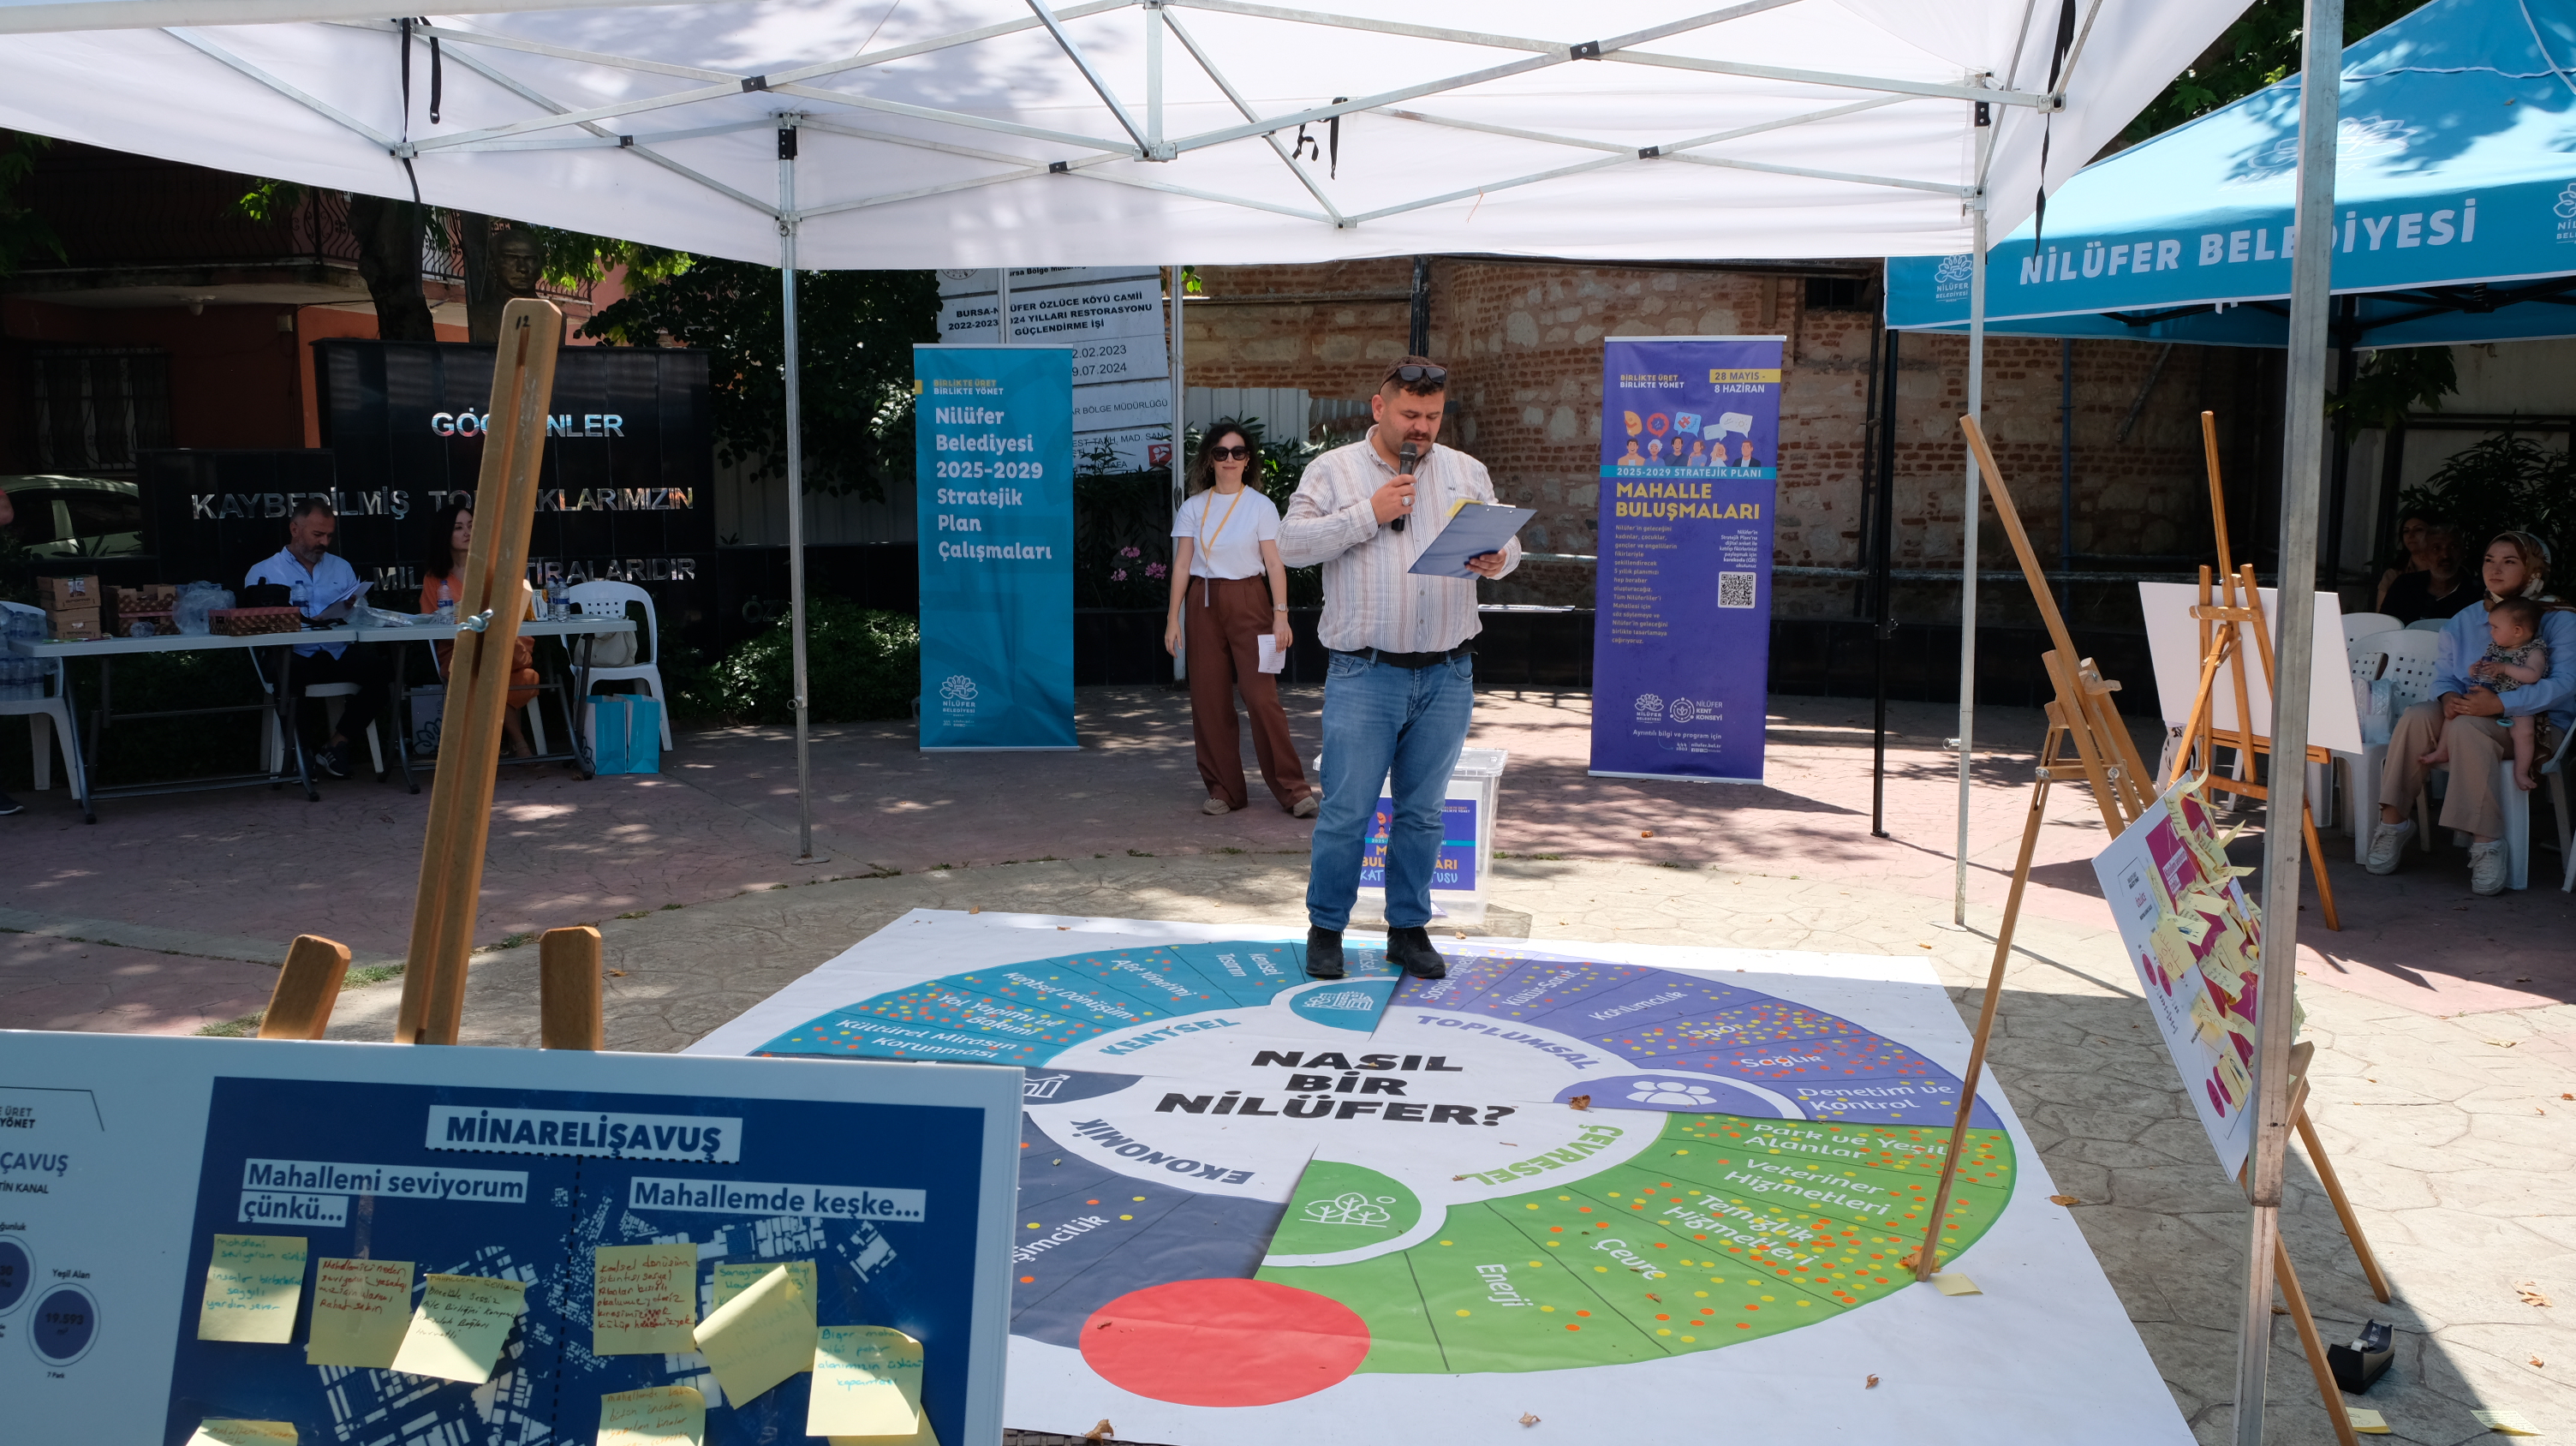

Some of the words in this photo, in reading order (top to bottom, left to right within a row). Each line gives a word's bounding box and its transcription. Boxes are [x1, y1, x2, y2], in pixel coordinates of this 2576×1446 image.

[2019, 241, 2180, 285] NİLÜFER
[1937, 283, 1969, 292] NİLÜFER
[956, 302, 1036, 318] BURSA-NÜFER
[1039, 299, 1079, 310] ÖZLÜCE
[1082, 295, 1111, 305] KÖYÜ
[1113, 291, 1142, 302] CAMİİ
[1029, 313, 1067, 323] YILLARI
[1070, 303, 1153, 318] RESTORASYONU
[516, 314, 531, 331] 12
[1015, 320, 1088, 337] GÜÇLENDİRME
[1091, 319, 1105, 329] İŞİ
[1072, 344, 1127, 359] 2.02.2023
[1072, 362, 1127, 376] 9.07.2024
[1714, 372, 1727, 381] 28
[1730, 372, 1760, 380] MAYIS
[933, 386, 974, 395] BİRLİKTE
[975, 386, 1005, 396] YÖNET
[975, 379, 997, 387] ÜRET
[1658, 380, 1685, 389] YÖNET
[1714, 385, 1720, 393] 8
[1722, 383, 1765, 393] HAZİRAN
[935, 407, 1005, 425] Nilüfer
[1082, 404, 1112, 415] BÖLGE
[1113, 398, 1168, 411] MÜDÜRLÜĞÜ
[432, 408, 624, 437] GÖNLER
[936, 433, 1034, 456] Belediyesi
[1121, 433, 1143, 443] MAD.
[937, 461, 1043, 479] 2025-2029
[1617, 467, 1671, 476] 2025-2029
[1674, 467, 1727, 477] STRATEJİK
[1731, 469, 1762, 478] PLANI
[428, 487, 693, 512] TOKLARIMIZIN
[937, 487, 1023, 509] Stratejik
[1616, 482, 1712, 499] MAHALLE
[1615, 502, 1760, 521] BULUŞMALARI
[938, 514, 981, 532] Plan
[939, 541, 1052, 562] Çalışmaları
[526, 558, 696, 584] TIRALARIDIR
[1696, 700, 1723, 708] NİLÜFER
[1658, 730, 1673, 738] bilgi
[1216, 953, 1247, 977] Tasarım
[1249, 953, 1285, 976] Kentsel
[1112, 959, 1140, 972] Afet
[1137, 967, 1198, 997] Yönetimi
[1003, 971, 1062, 995] Kentsel
[1056, 986, 1135, 1019] Dönüşüm
[1419, 979, 1457, 1000] Sosyal
[938, 994, 964, 1007] Yol
[970, 1001, 1030, 1025] Yapımı
[1035, 1016, 1063, 1027] ve
[1588, 990, 1689, 1021] Katılımcılık
[836, 1019, 923, 1038] Kültürel
[930, 1030, 1018, 1051] Mirasın
[966, 1015, 1039, 1036] Bakımı
[1099, 1018, 1243, 1055] KENTSEL
[871, 1037, 999, 1059] Korunması
[1417, 1015, 1601, 1070] TOPLUMSAL
[1251, 1050, 1464, 1073] NASIL
[1740, 1054, 1826, 1068] Sağlık
[1285, 1071, 1408, 1096] BİR
[1797, 1084, 1916, 1097] Denetim
[1920, 1084, 1956, 1095] ve
[5, 1105, 33, 1117] ÜRET
[1154, 1090, 1516, 1126] NİLÜFER?
[1809, 1099, 1922, 1112] Kontrol
[0, 1116, 36, 1128] YÖNET
[446, 1109, 722, 1160] MİNARELİŞAVUŞ
[1753, 1123, 1823, 1141] Park
[1832, 1134, 1868, 1145] ve
[1876, 1137, 1950, 1156] Yeşil
[1070, 1118, 1256, 1185] EKONOMİK
[1456, 1124, 1624, 1186] ÇEVRESEL
[1744, 1136, 1868, 1159] Alanlar
[247, 1163, 382, 1192] Mahallemi
[387, 1171, 524, 1199] seviyorum
[1746, 1158, 1886, 1195] Veteriner
[15, 1182, 49, 1194] KANAL
[1723, 1170, 1892, 1216] Hizmetleri
[243, 1195, 343, 1223] çünkü...
[635, 1181, 805, 1211] Mahallemde
[814, 1188, 921, 1219] keşke...
[1697, 1193, 1814, 1244] Temizlik
[1013, 1216, 1111, 1264] şimcilik
[1662, 1205, 1821, 1266] Hizmetleri
[52, 1269, 71, 1279] Yeşil
[72, 1270, 91, 1279] Alan
[1475, 1264, 1535, 1307] Enerji
